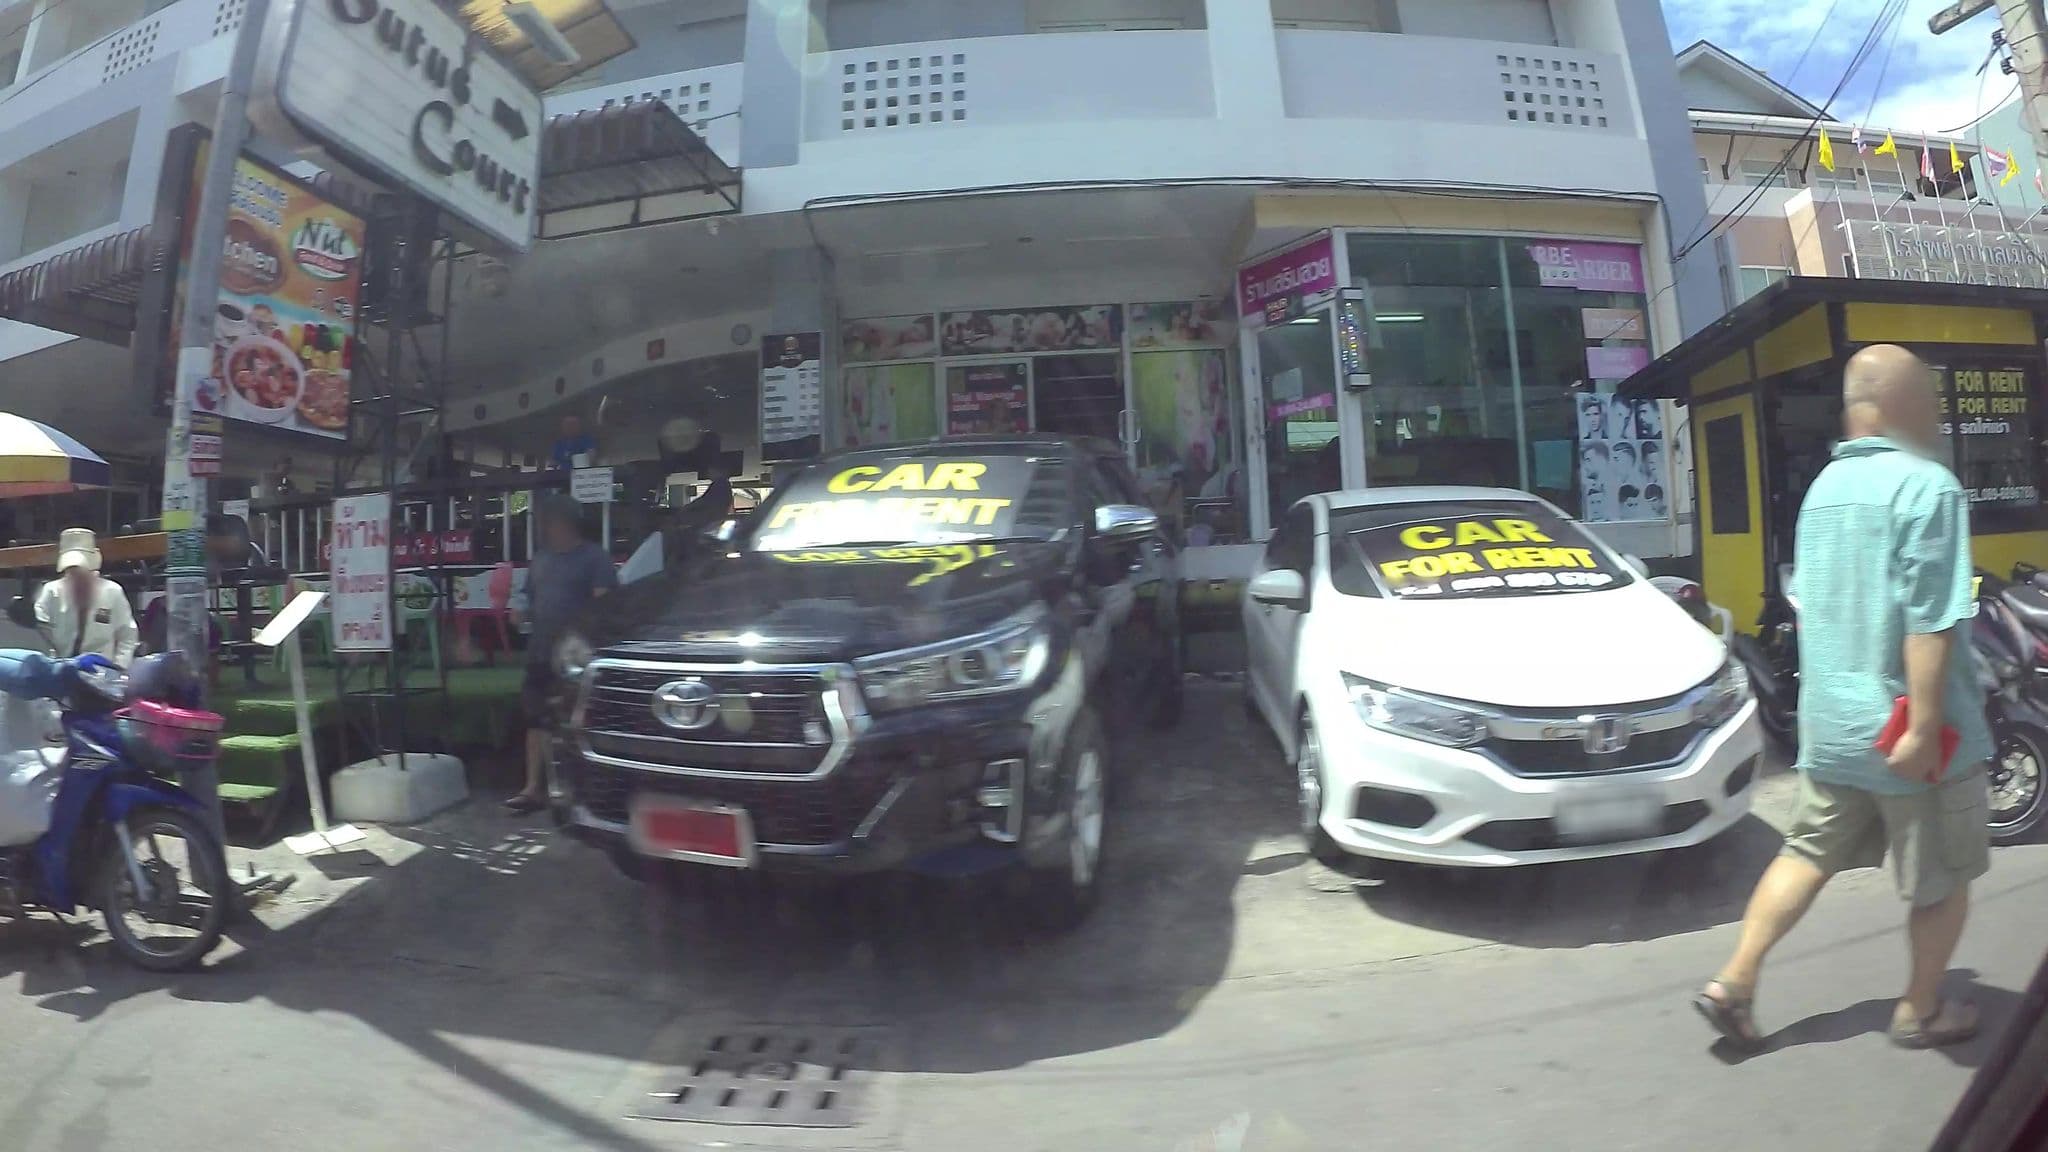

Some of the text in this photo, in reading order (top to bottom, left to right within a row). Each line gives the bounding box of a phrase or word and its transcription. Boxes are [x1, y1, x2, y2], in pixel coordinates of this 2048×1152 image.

[412, 100, 530, 214] Court
[222, 234, 278, 275] tchen
[1954, 371, 1985, 392] FOR
[1988, 371, 2025, 392] RENT
[1957, 397, 1987, 414] FOR
[1991, 397, 2027, 414] RENT
[827, 463, 988, 494] CAR
[1400, 519, 1555, 550] CAR
[1379, 547, 1598, 580] FOR RENT
